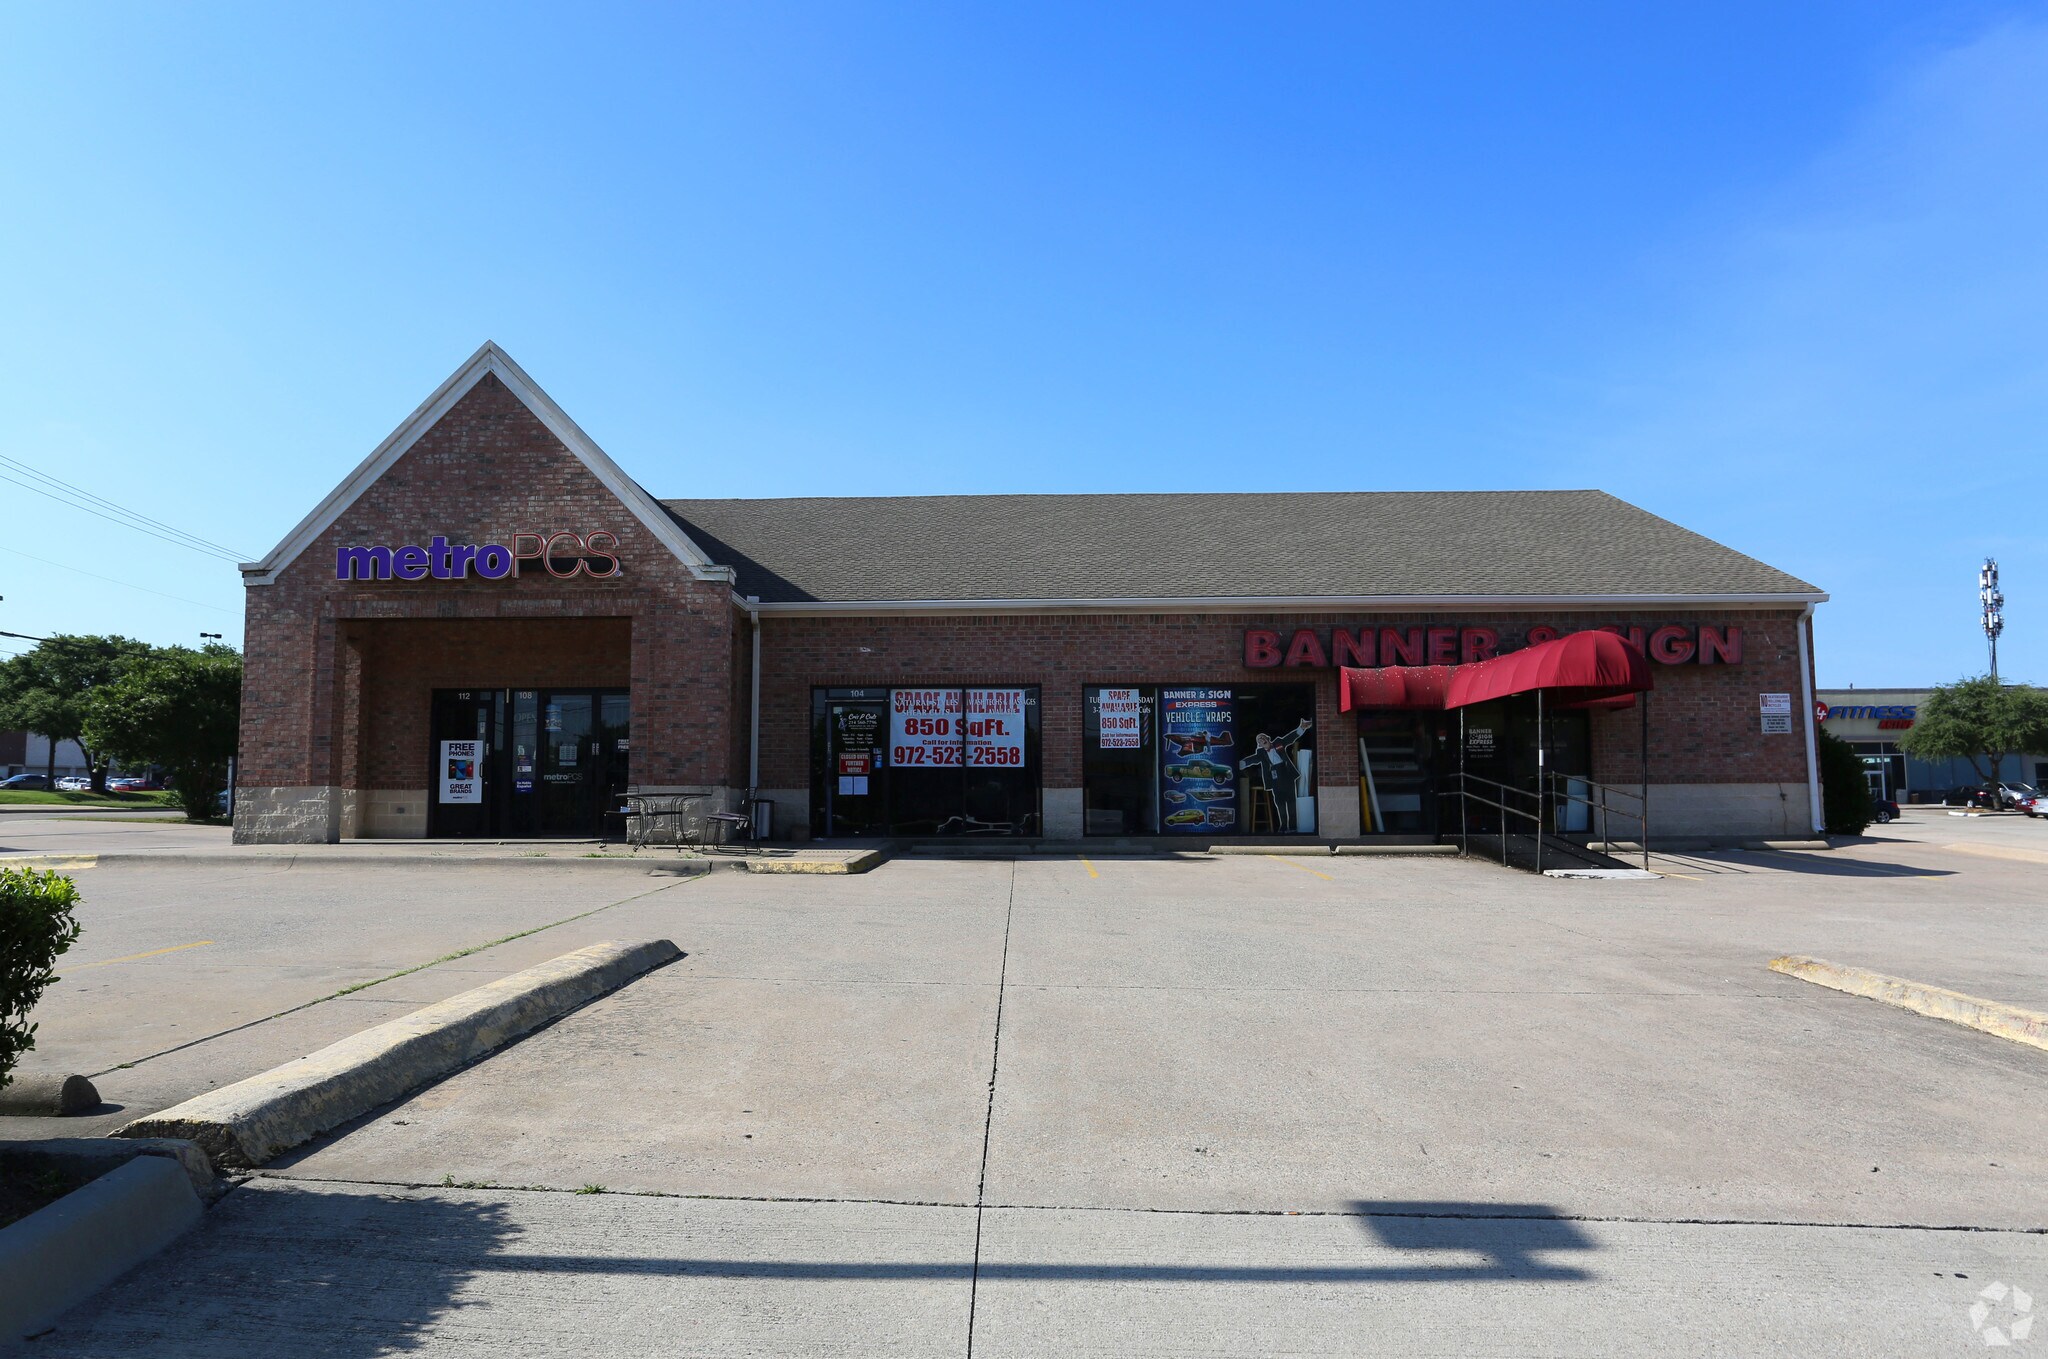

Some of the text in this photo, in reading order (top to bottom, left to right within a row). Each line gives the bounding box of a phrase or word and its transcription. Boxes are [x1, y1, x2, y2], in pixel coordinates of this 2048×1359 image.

[336, 531, 620, 580] metroPCS
[1244, 628, 1499, 667] BANNER
[1600, 625, 1743, 665] IGN
[519, 691, 533, 699] 108
[1108, 690, 1131, 700] SPACE
[1163, 690, 1232, 699] BANNER & SIGN
[1166, 711, 1232, 722] VEHICLE WRAPS
[1827, 705, 1917, 719] FITNESS
[905, 718, 1010, 738] 850 SqFt.
[1102, 717, 1138, 730] 850 SqFt.
[894, 746, 1020, 764] 972-523-2558
